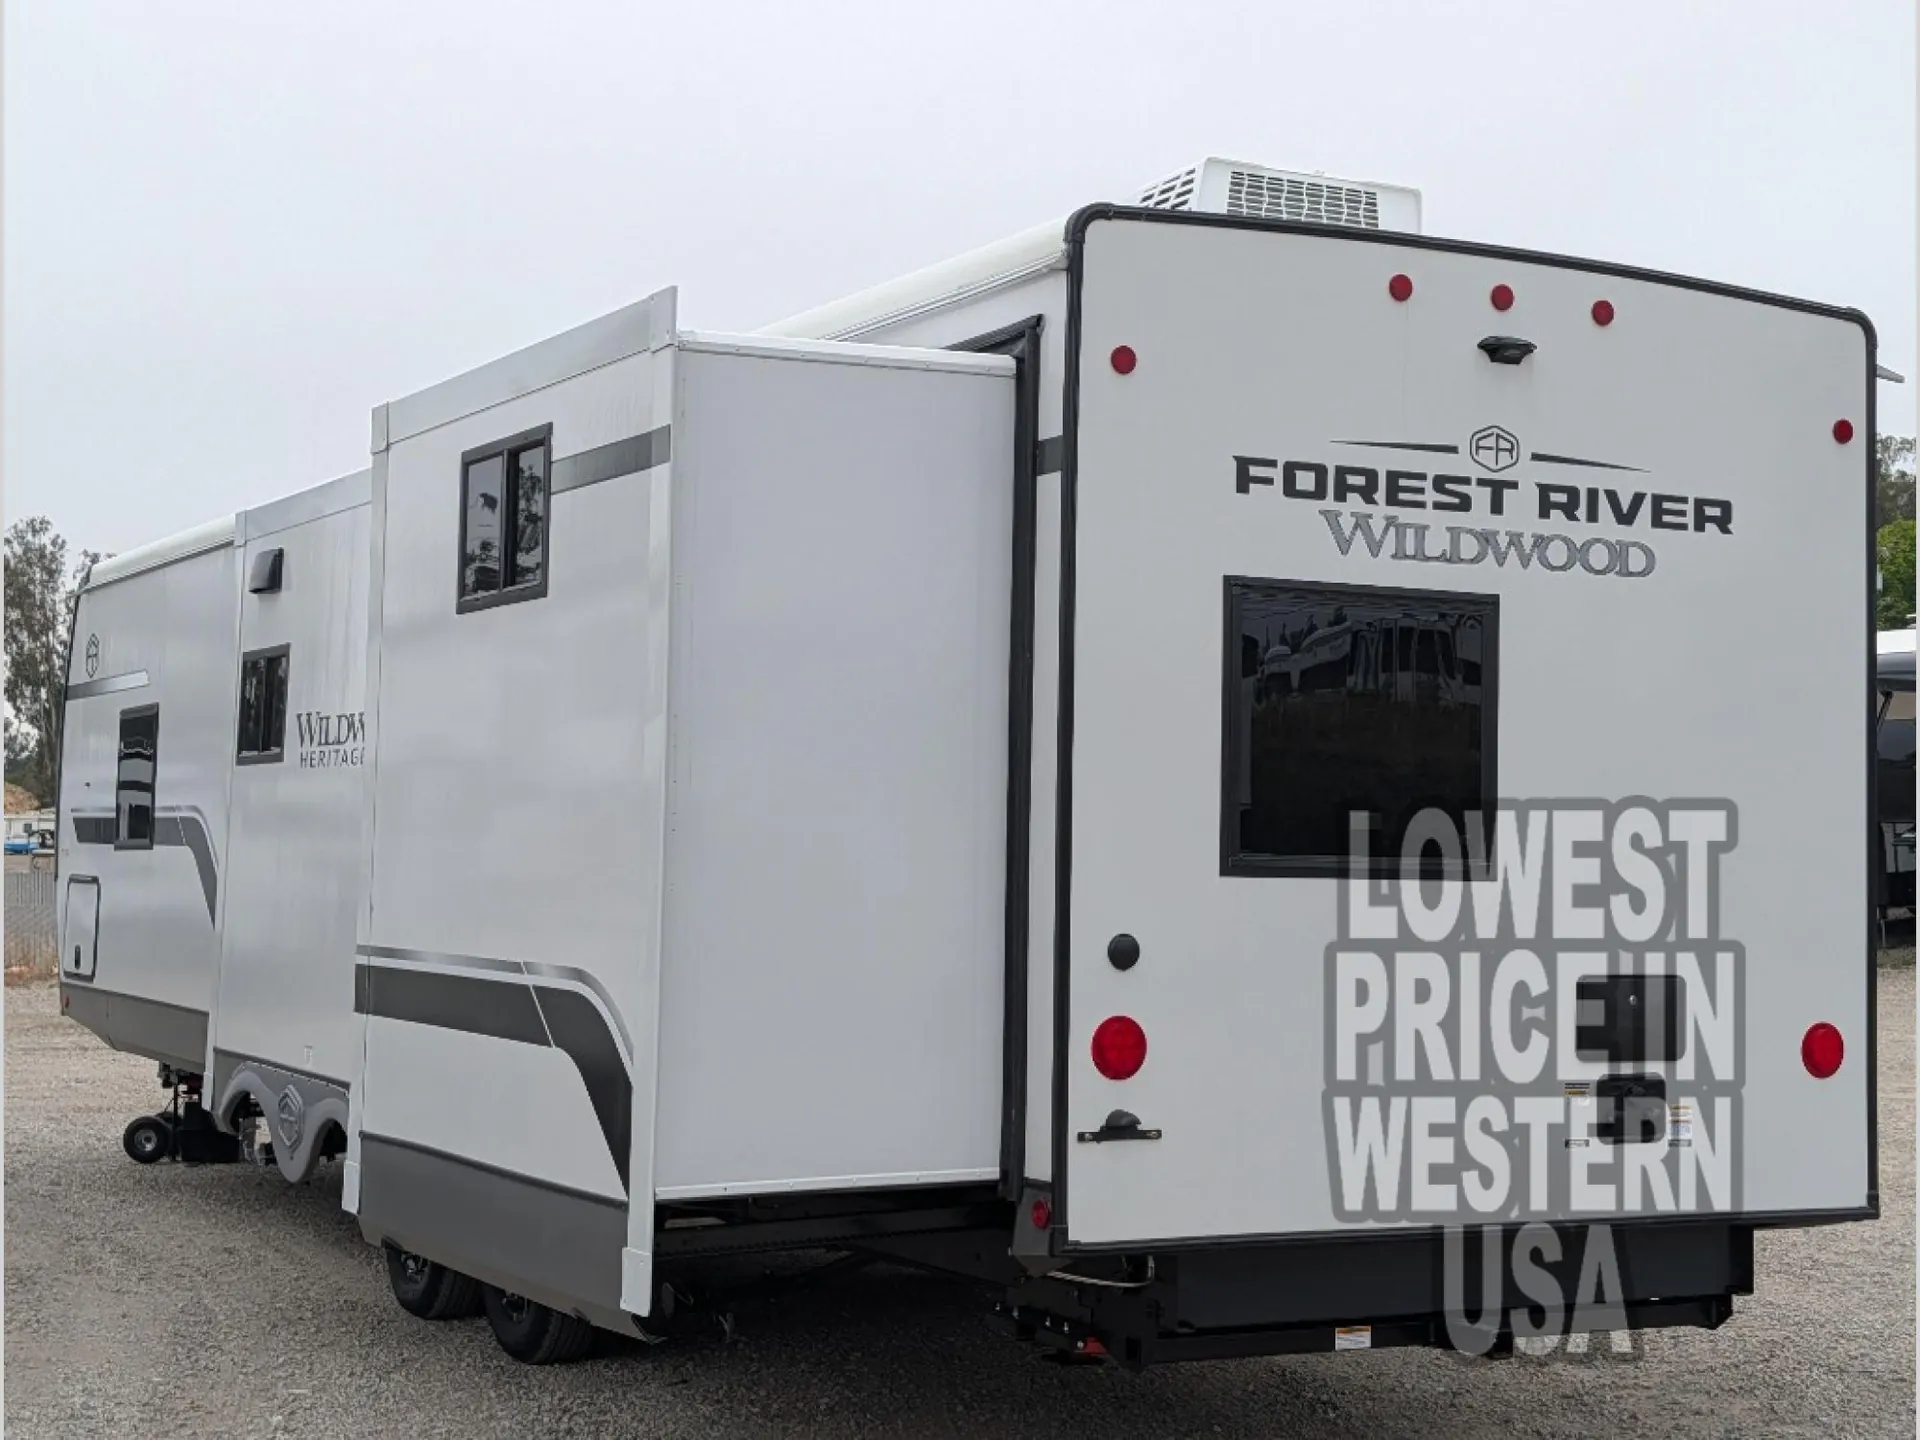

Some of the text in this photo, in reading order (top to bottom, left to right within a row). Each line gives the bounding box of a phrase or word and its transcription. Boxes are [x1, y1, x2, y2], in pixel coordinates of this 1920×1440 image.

[1232, 455, 1734, 534] FOREST RIVER
[1318, 508, 1656, 578] WILDWOOD
